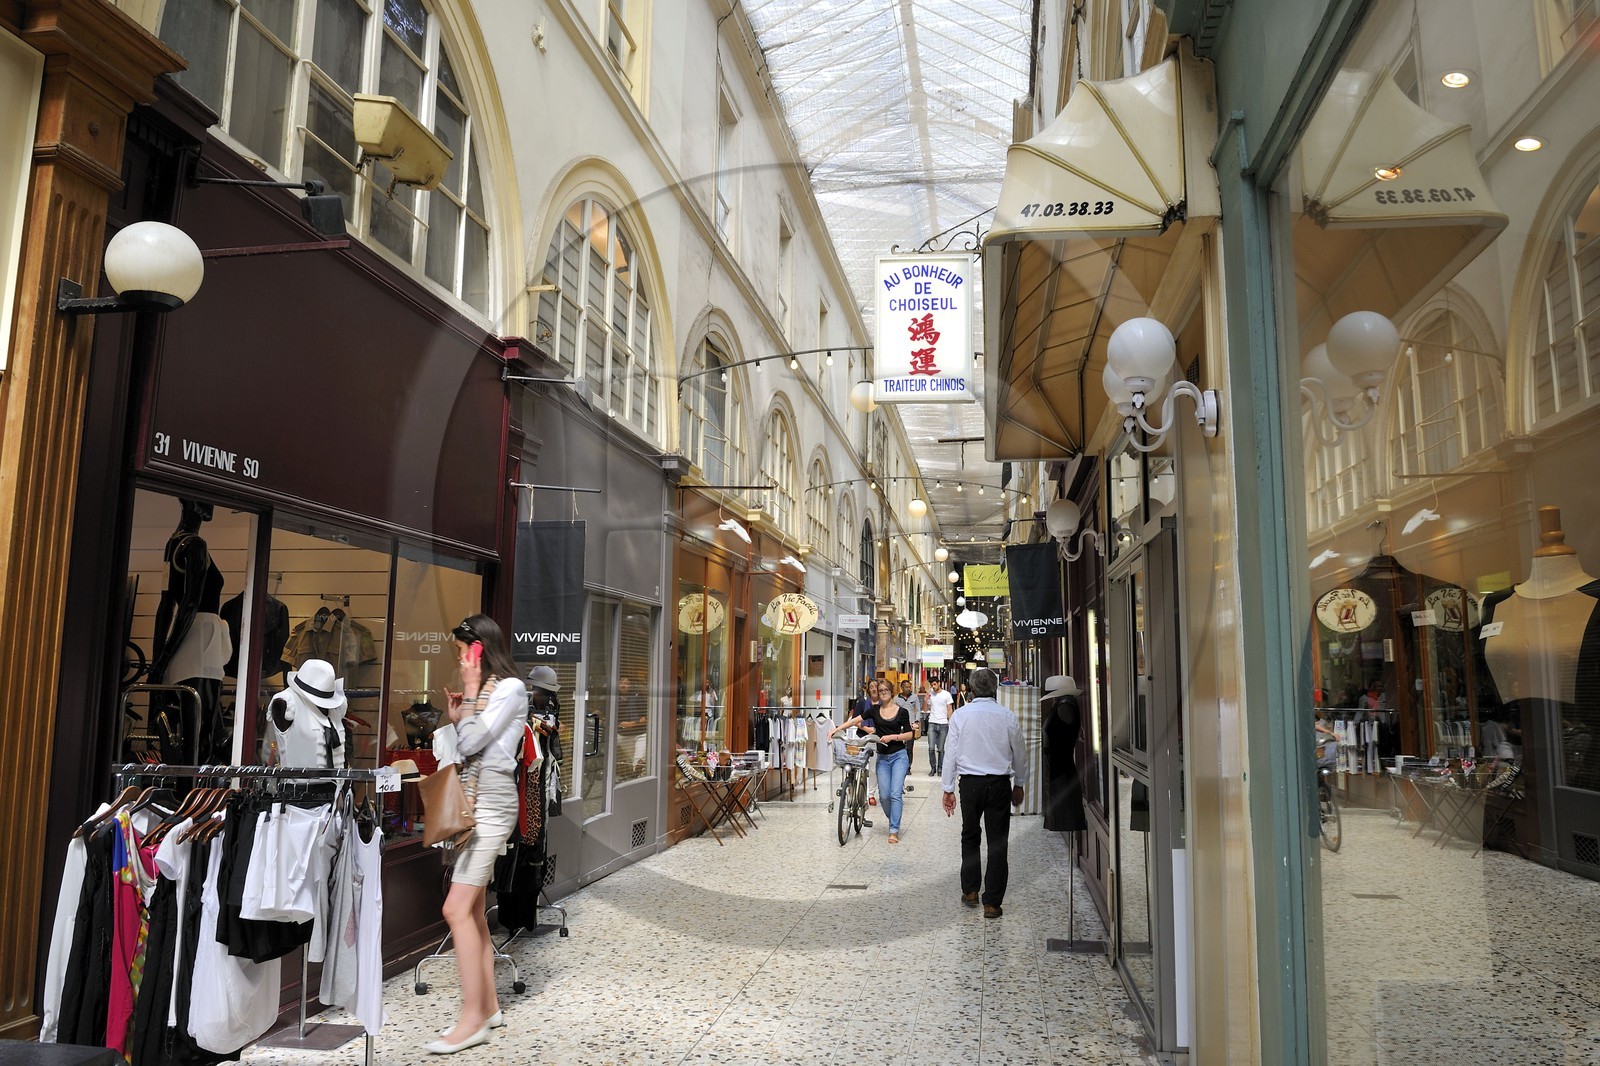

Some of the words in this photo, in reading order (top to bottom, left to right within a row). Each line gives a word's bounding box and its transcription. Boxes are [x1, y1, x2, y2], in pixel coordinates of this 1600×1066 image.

[1021, 201, 1114, 217] 47.03.38.33
[883, 272, 901, 291] AU
[902, 264, 963, 289] BONHEUR
[914, 282, 932, 294] DE
[889, 297, 957, 311] CHOISEUL
[884, 379, 927, 392] TRAITEUR
[930, 378, 965, 391] CHINOIS
[154, 431, 171, 456] 31
[182, 438, 237, 473] VIVIENNE
[243, 457, 259, 479] SO
[770, 600, 781, 613] La
[782, 593, 796, 603] Vie
[1013, 617, 1063, 627] VIVIENNE
[514, 632, 581, 643] VIVIENNE
[536, 645, 557, 655] SO
